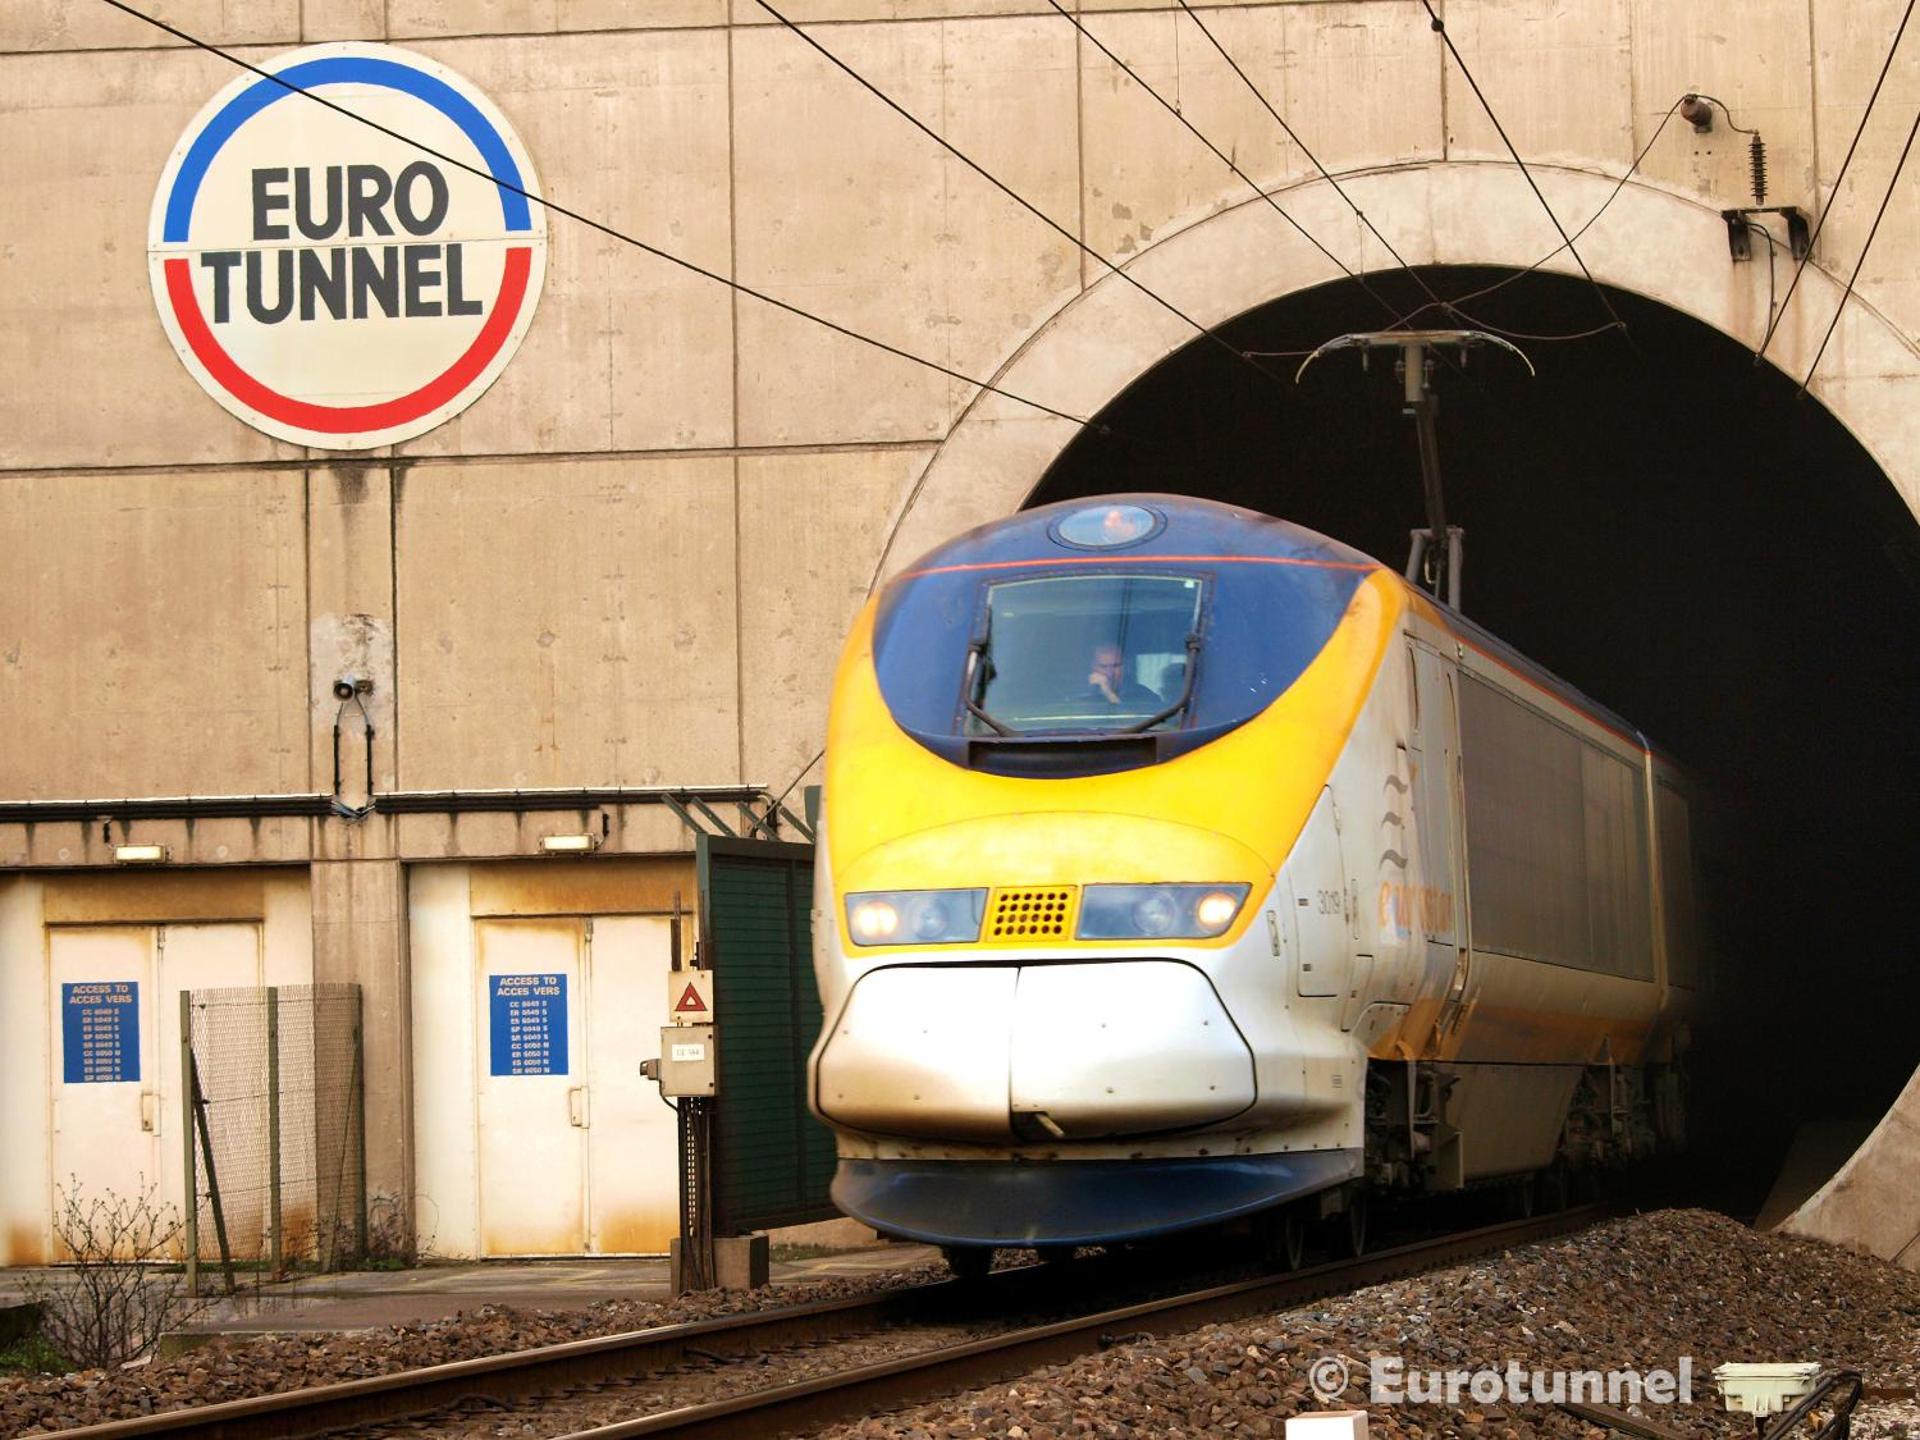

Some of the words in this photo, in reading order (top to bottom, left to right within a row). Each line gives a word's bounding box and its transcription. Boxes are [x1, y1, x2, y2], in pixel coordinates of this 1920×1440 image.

[252, 160, 449, 241] EURO
[201, 243, 483, 324] TUNNEL
[500, 976, 540, 985] ACCESS
[543, 976, 557, 984] TO
[72, 984, 111, 994] ACCESS
[115, 984, 128, 993] TO
[496, 987, 529, 996] ACCES
[533, 986, 560, 995] VERS
[69, 995, 102, 1005] ACCES
[106, 994, 132, 1003] VERS
